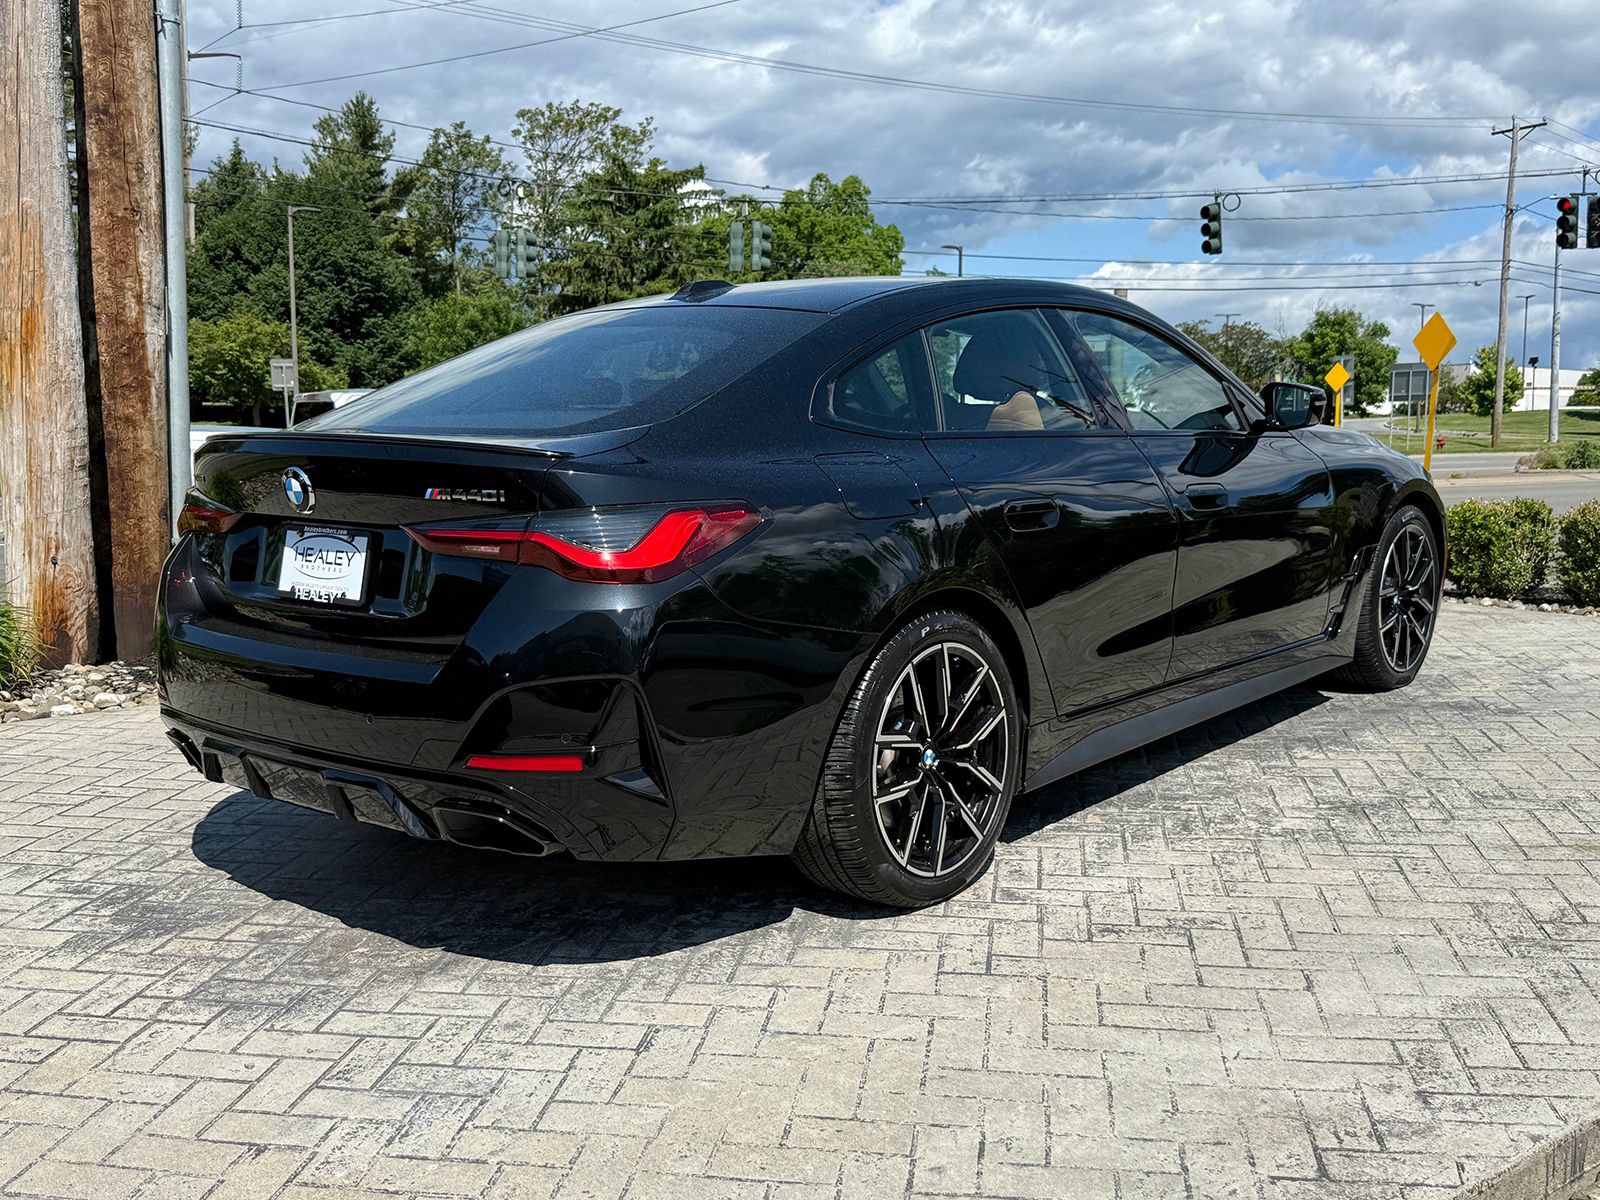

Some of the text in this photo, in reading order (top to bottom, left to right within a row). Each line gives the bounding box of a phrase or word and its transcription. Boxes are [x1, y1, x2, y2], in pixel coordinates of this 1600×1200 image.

[295, 546, 356, 567] HEALEY
[301, 564, 342, 574] BROTHERS
[295, 588, 338, 603] HEALEY
